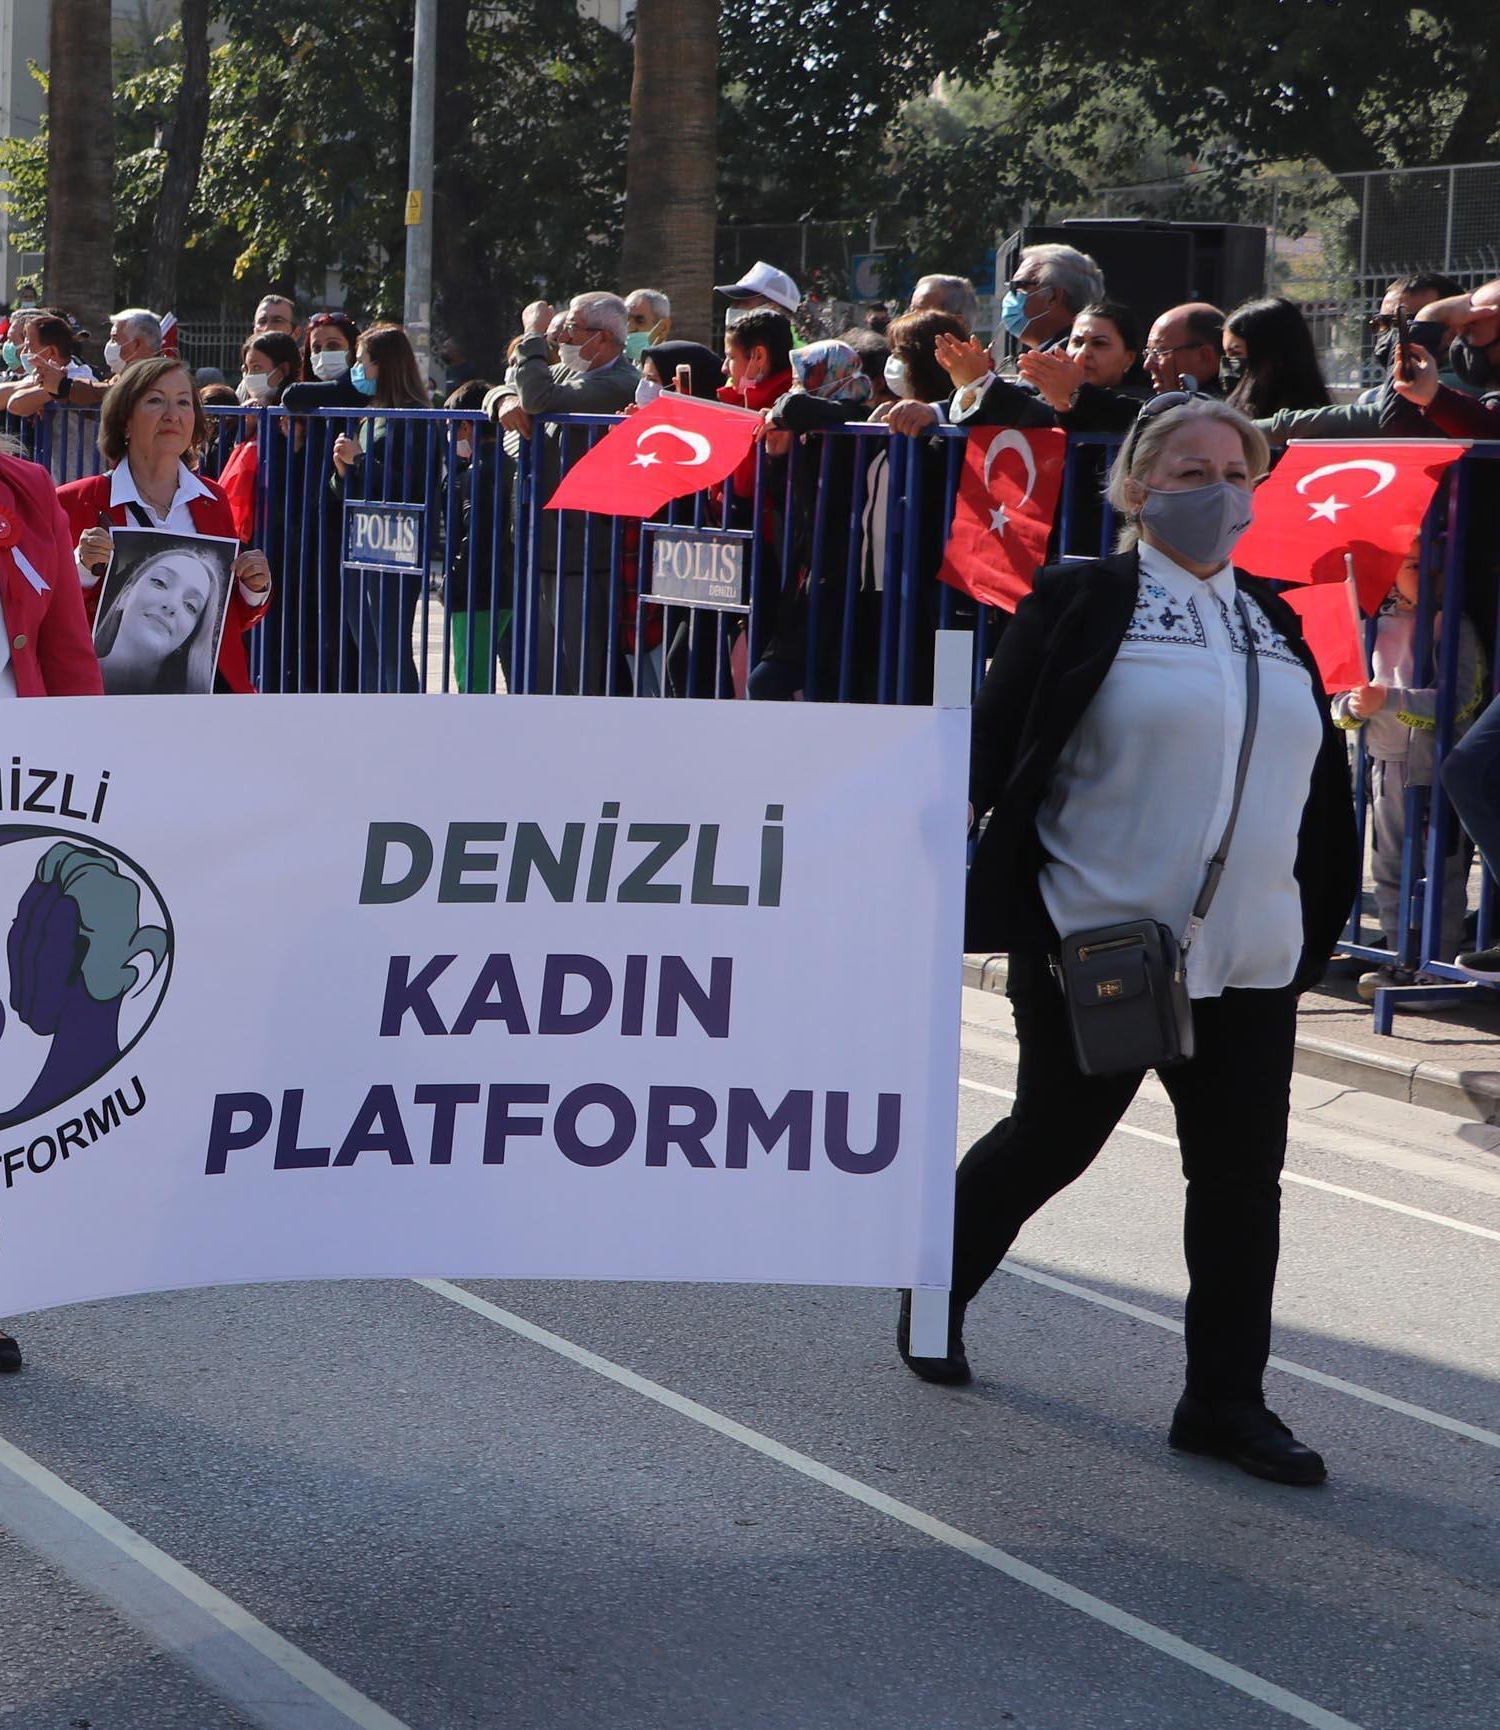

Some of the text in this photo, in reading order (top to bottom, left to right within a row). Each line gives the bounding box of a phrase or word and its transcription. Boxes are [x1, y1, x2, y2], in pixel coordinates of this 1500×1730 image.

[356, 511, 414, 552] POLİS
[655, 537, 737, 584] POLİS
[359, 801, 784, 907] DENİZLİ
[379, 953, 733, 1038] KADIN
[205, 1083, 902, 1176] PLATFORMU
